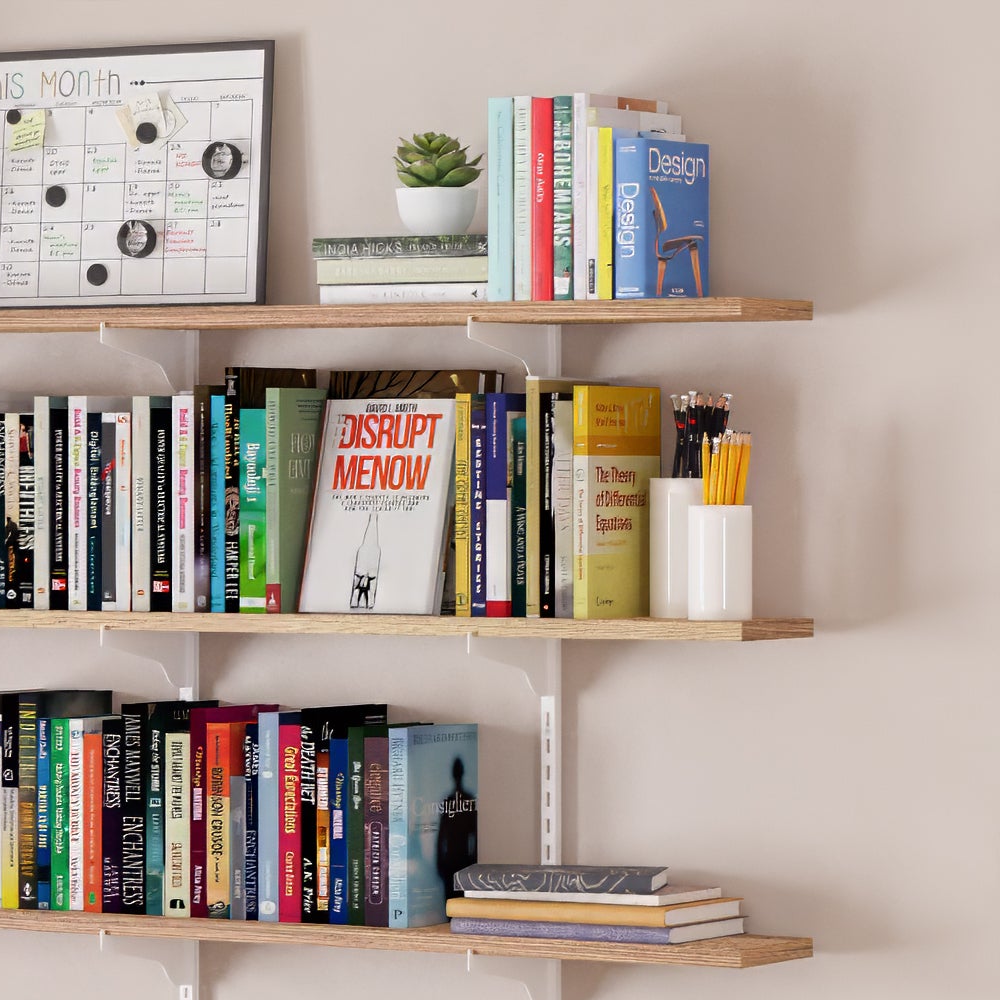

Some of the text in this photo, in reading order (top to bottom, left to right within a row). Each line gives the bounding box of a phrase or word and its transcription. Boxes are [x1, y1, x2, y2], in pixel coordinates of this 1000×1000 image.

[649, 148, 706, 185] Design
[554, 140, 571, 247] BOHEMIANS
[618, 182, 639, 257] Design
[362, 242, 403, 255] HICKS
[338, 414, 443, 449] DISRUPT
[226, 541, 238, 579] HARPER
[104, 734, 120, 808] ENCHANTRESS
[301, 741, 315, 779] DEATH
[122, 714, 143, 905] JAMES MAXWELL ENCHANTRESS
